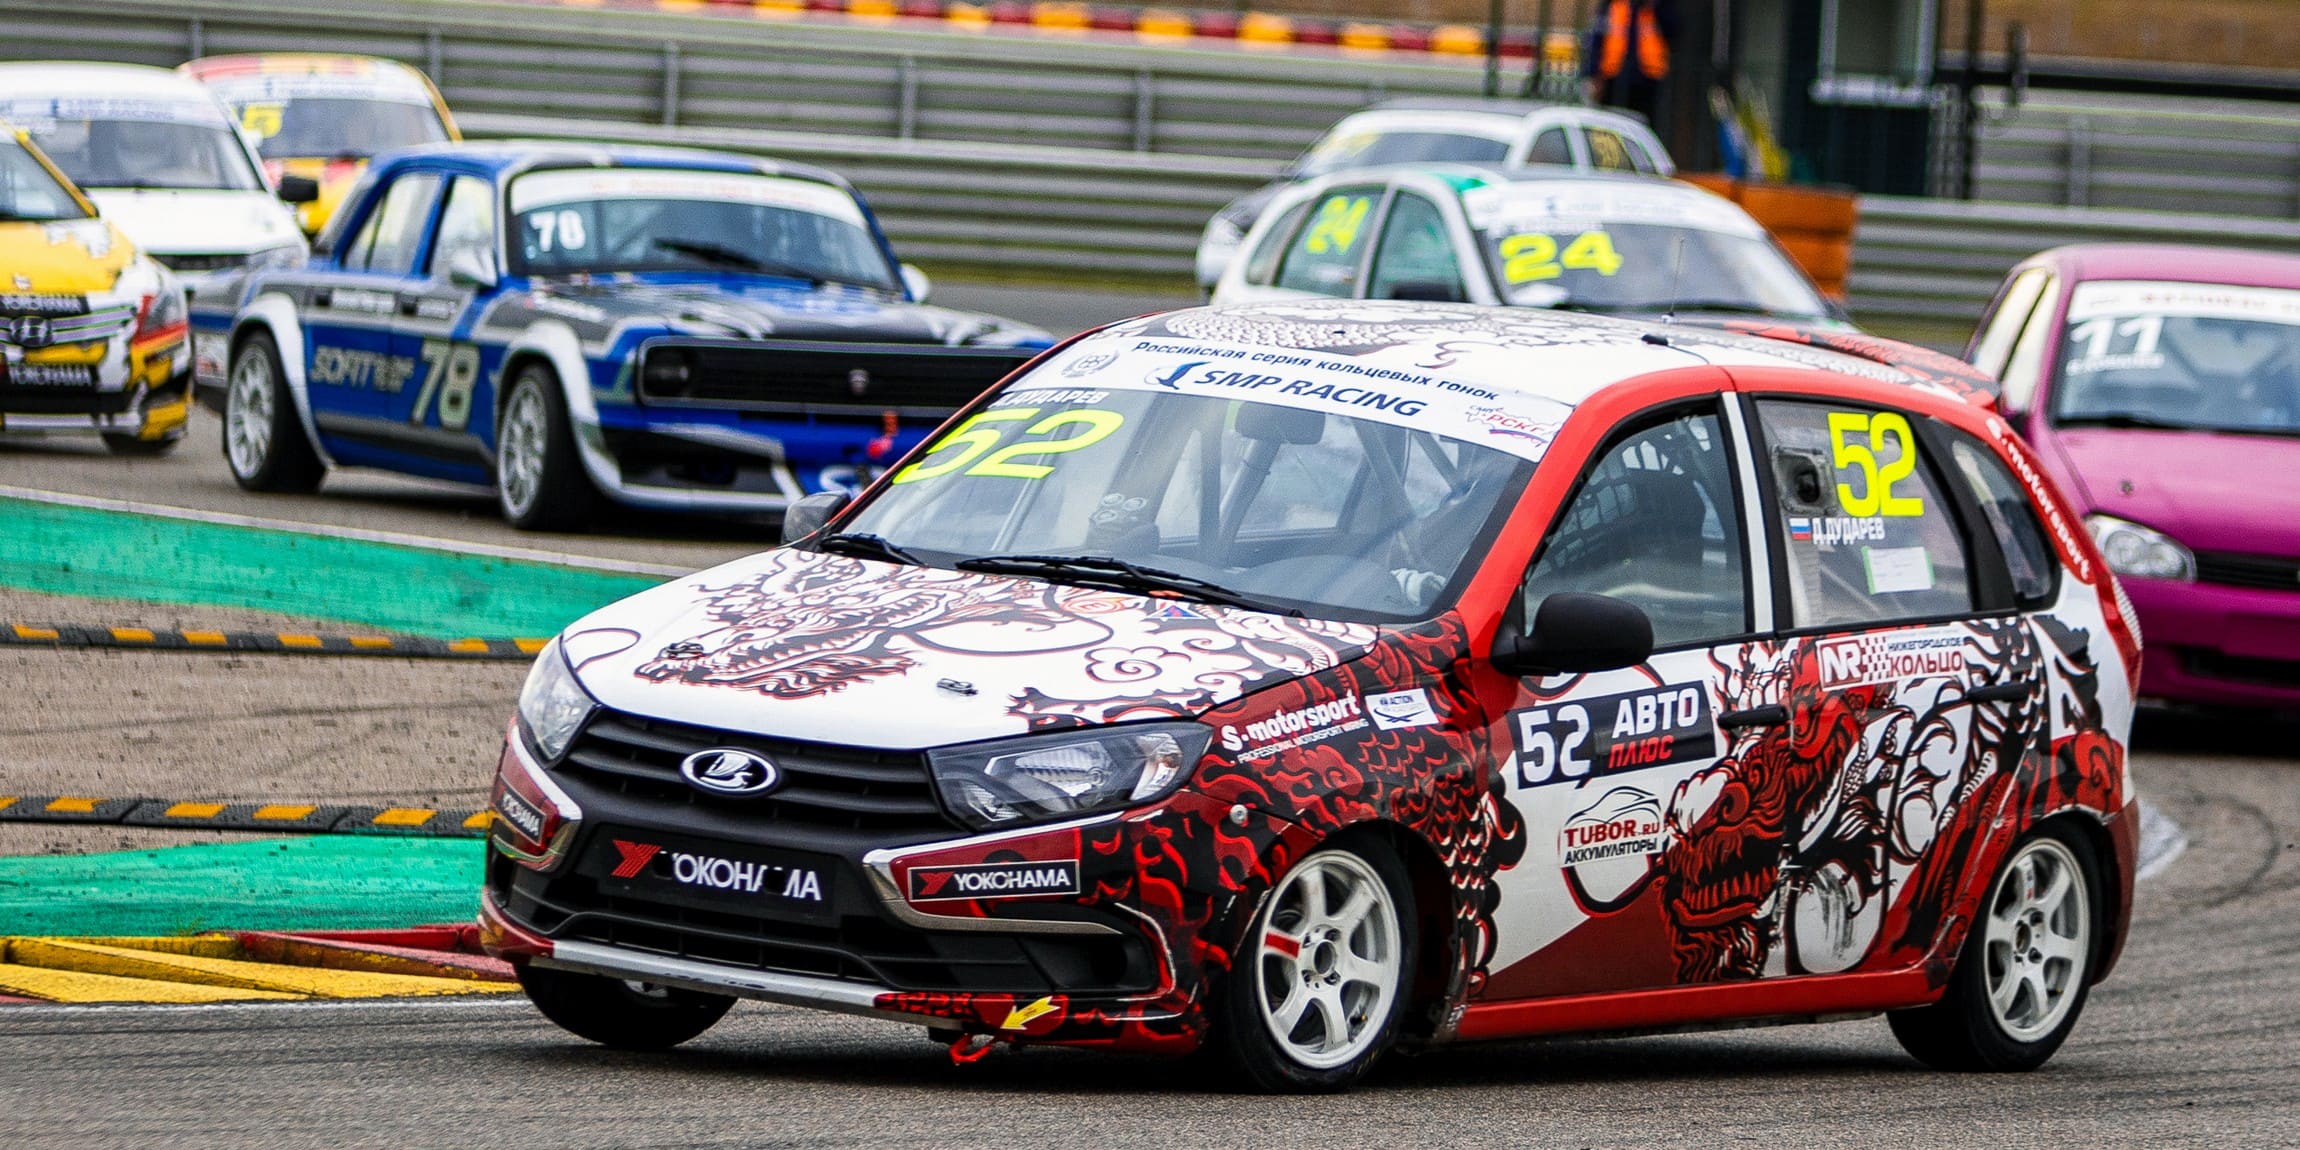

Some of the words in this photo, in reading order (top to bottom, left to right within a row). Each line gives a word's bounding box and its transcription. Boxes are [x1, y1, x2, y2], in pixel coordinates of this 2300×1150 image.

[530, 209, 586, 252] 78
[1499, 231, 1624, 285] 24
[2070, 315, 2163, 359] 11
[410, 339, 480, 430] 78
[1131, 341, 1247, 359] Российская
[1251, 352, 1312, 367] серия
[1315, 360, 1433, 386] кольцевых
[1437, 379, 1500, 401] гонок
[1194, 370, 1283, 390] SMP
[1278, 380, 1428, 417] RACING
[893, 407, 1124, 485] 52
[1828, 412, 1924, 517] 52
[1888, 651, 1963, 678] КОЛЬЦО
[1612, 688, 1699, 739] АВТО
[1518, 704, 1591, 783] 52
[1608, 735, 1674, 769] ПЛЮС
[1564, 838, 1658, 864] АККУМУЛЯТОРЫ
[954, 868, 1071, 891] YOKOHAMA
